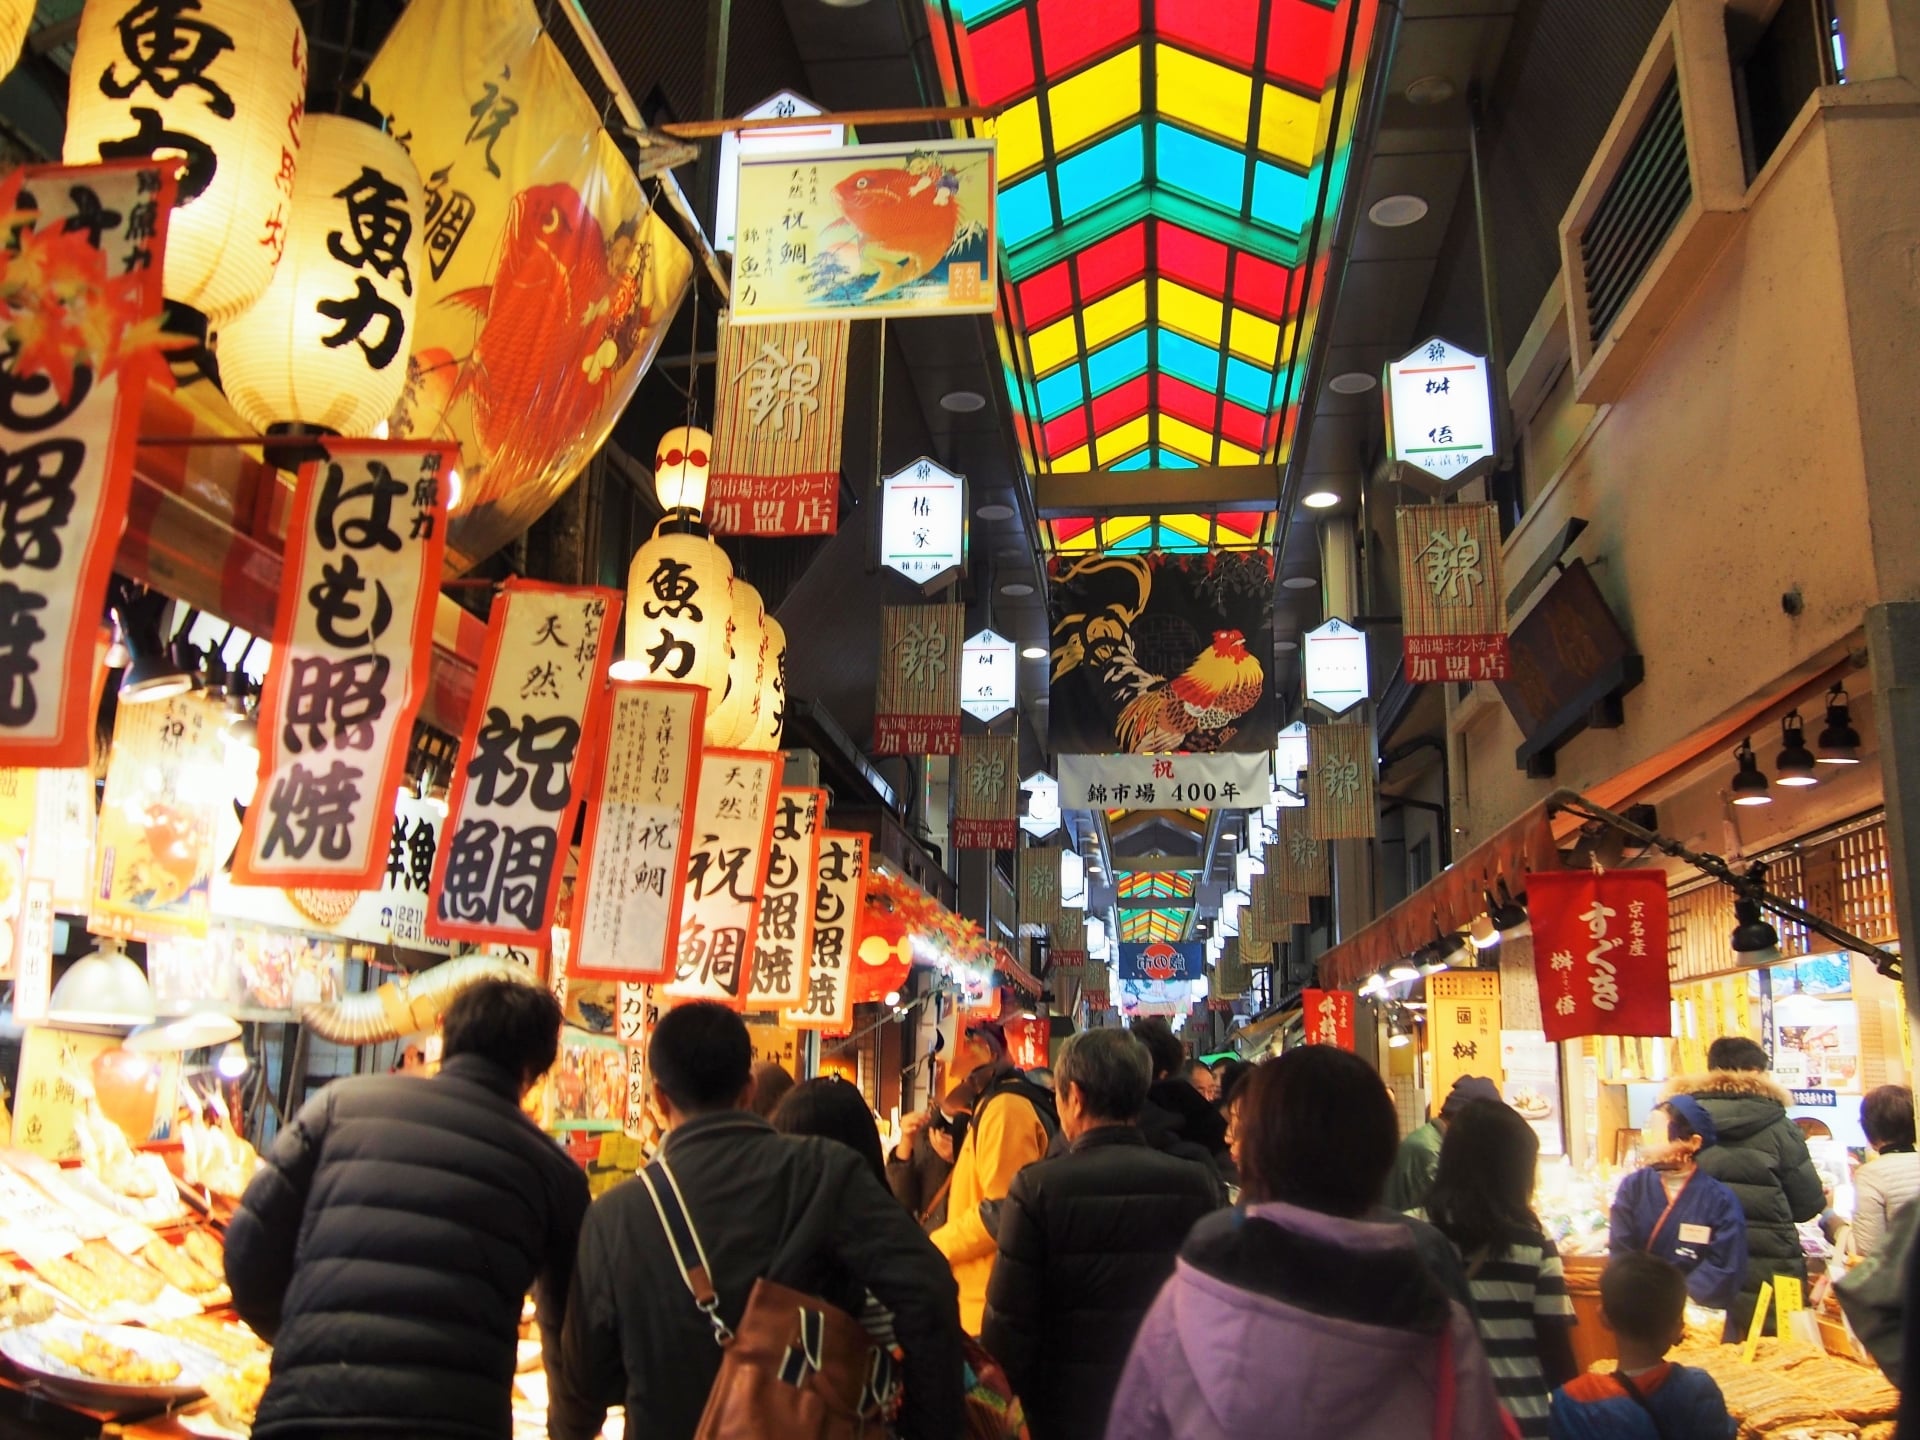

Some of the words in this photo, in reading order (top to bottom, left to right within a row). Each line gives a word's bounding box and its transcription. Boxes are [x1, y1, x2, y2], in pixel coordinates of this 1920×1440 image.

[779, 209, 809, 265] 祝鯛
[317, 165, 413, 371] 魚力
[708, 496, 833, 533] 加盟店
[710, 476, 834, 501] 錦市場ポイントカード
[643, 558, 703, 679] 魚力
[1408, 636, 1505, 655] 錦市場ポイントカード
[260, 460, 408, 862] はも照焼
[520, 614, 569, 700] 天然
[1410, 653, 1506, 682] 加盟店
[879, 731, 955, 754] 加盟店
[1152, 758, 1175, 780] 祝
[438, 707, 581, 931] 祝鯛
[715, 766, 746, 821] 天然
[1087, 783, 1156, 805] 錦市場
[1171, 781, 1241, 804] 400年
[630, 817, 673, 899] 祝鯛
[956, 832, 1013, 849] 加盟店
[676, 834, 758, 998] 祝鯛
[750, 796, 804, 994] はも照焼
[1578, 901, 1624, 1012] すぐき
[1627, 900, 1648, 958] 京名産
